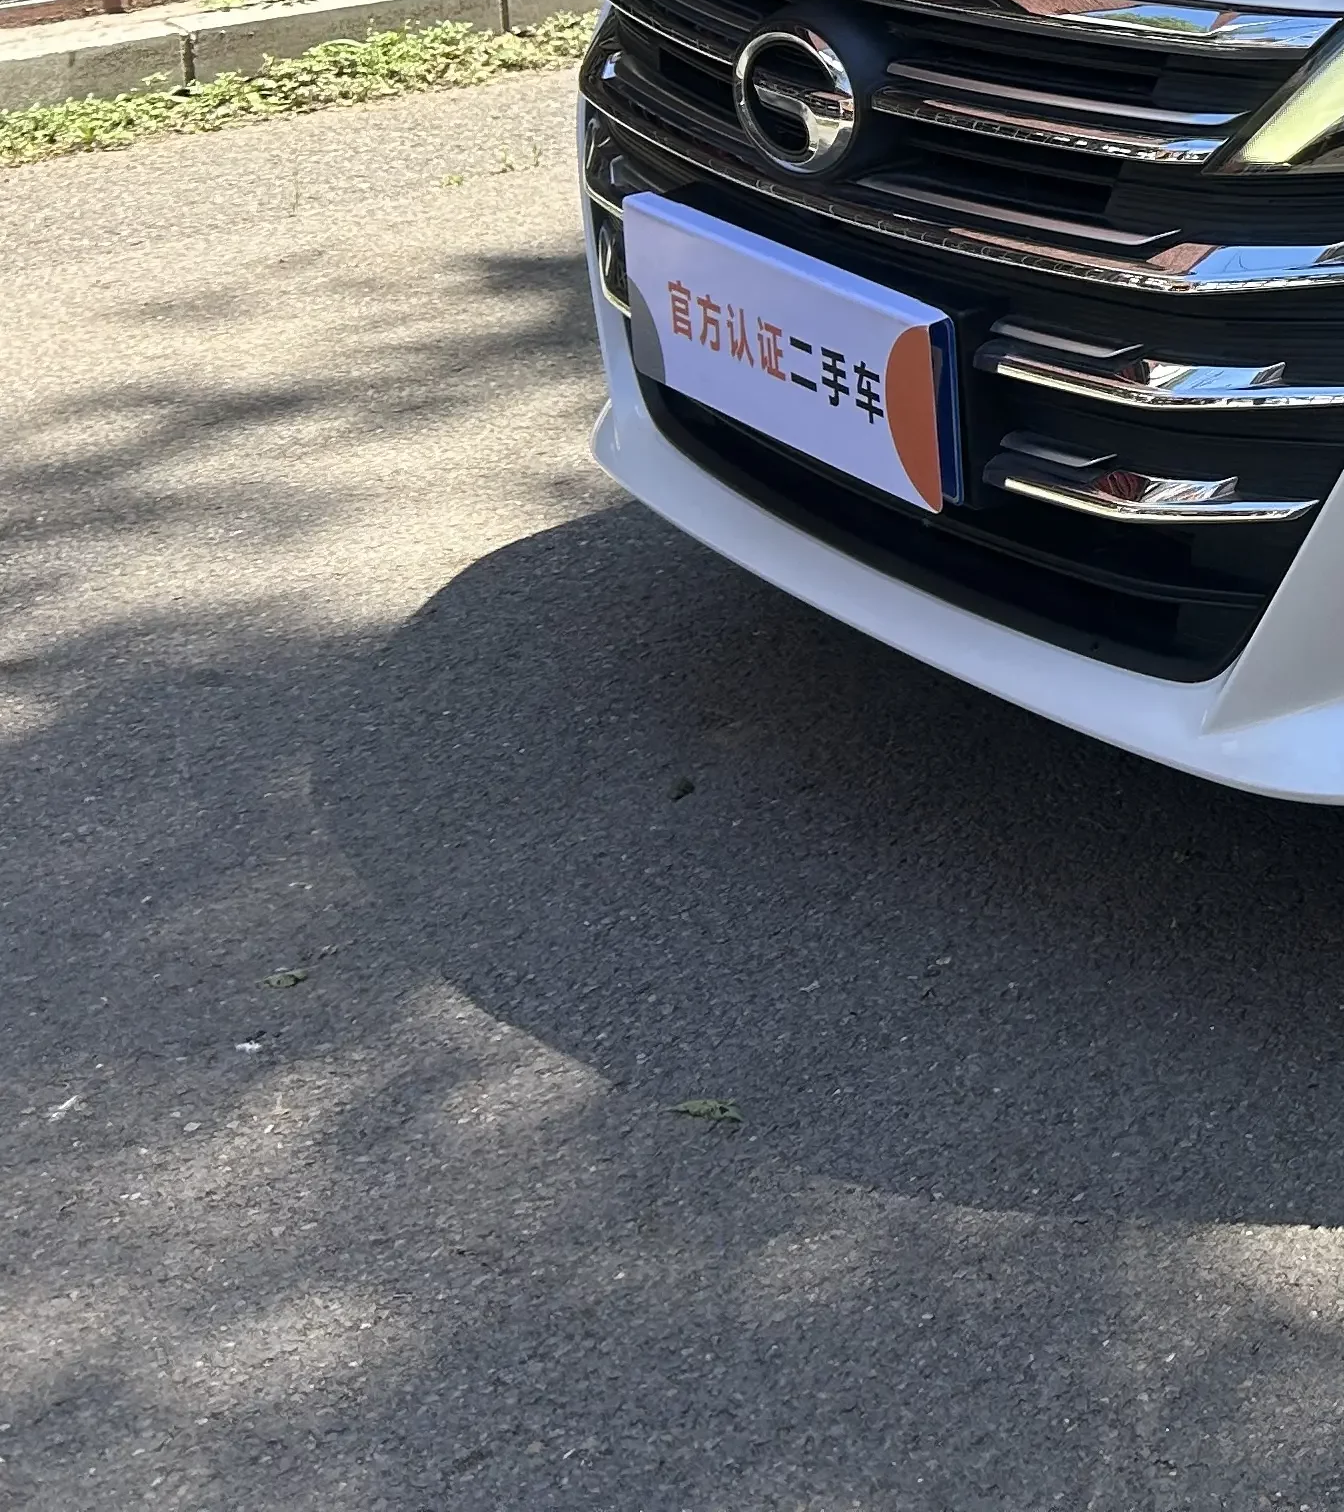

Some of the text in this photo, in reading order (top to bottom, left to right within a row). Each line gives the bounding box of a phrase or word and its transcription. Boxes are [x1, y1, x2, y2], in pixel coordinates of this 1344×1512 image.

[667, 279, 885, 425] 官方认证二手车
